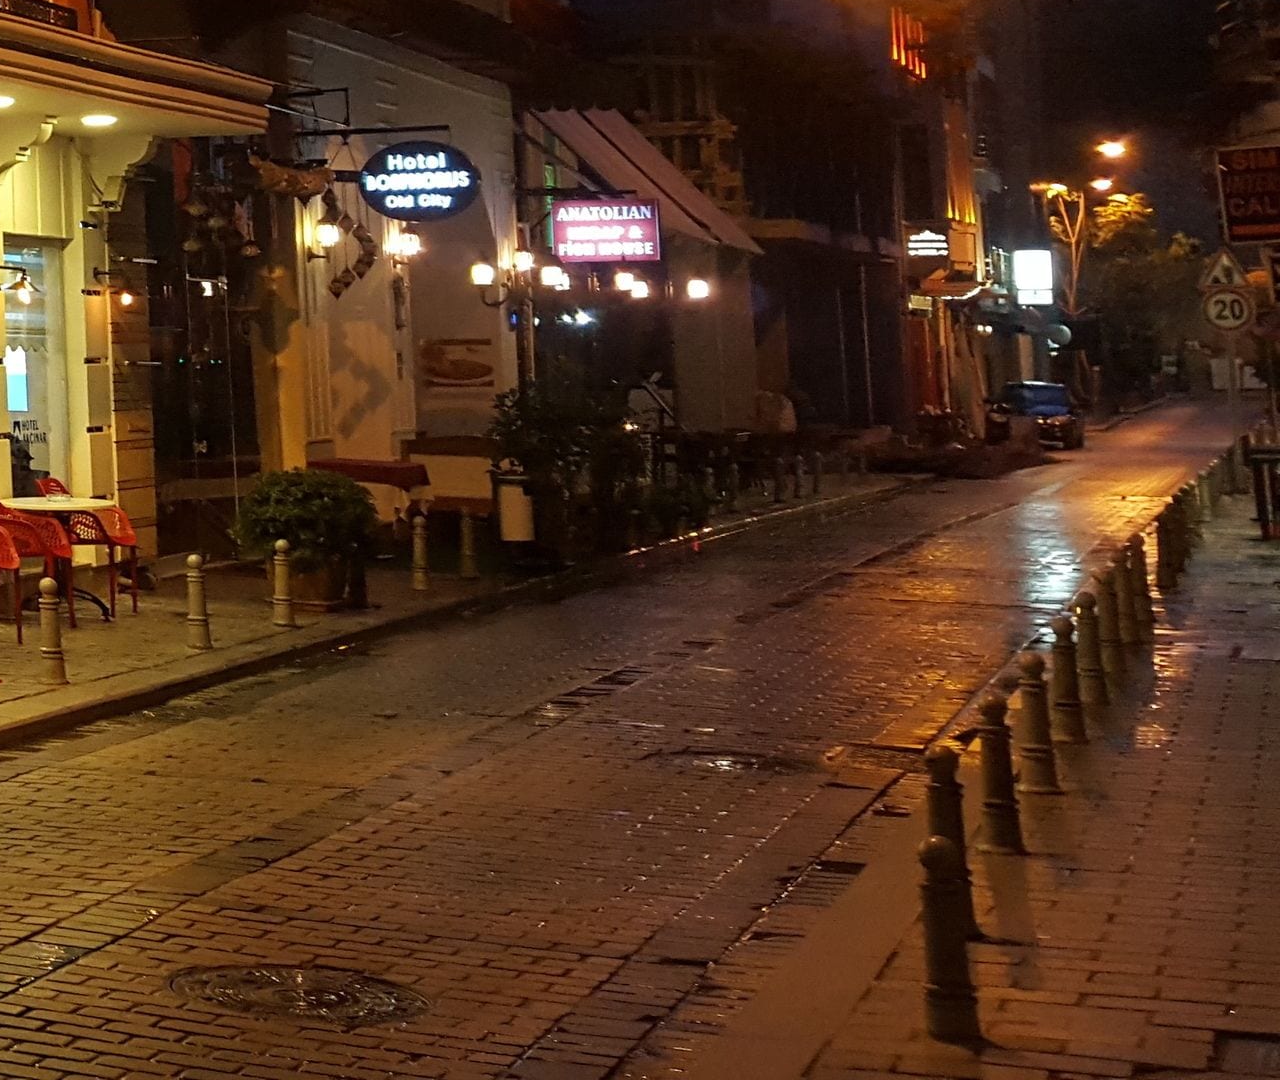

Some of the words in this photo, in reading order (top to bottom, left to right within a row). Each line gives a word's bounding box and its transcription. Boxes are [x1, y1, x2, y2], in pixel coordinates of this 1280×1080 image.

[387, 151, 446, 170] Hotel
[556, 206, 652, 221] ANATOLIAN
[1214, 299, 1244, 321] 20
